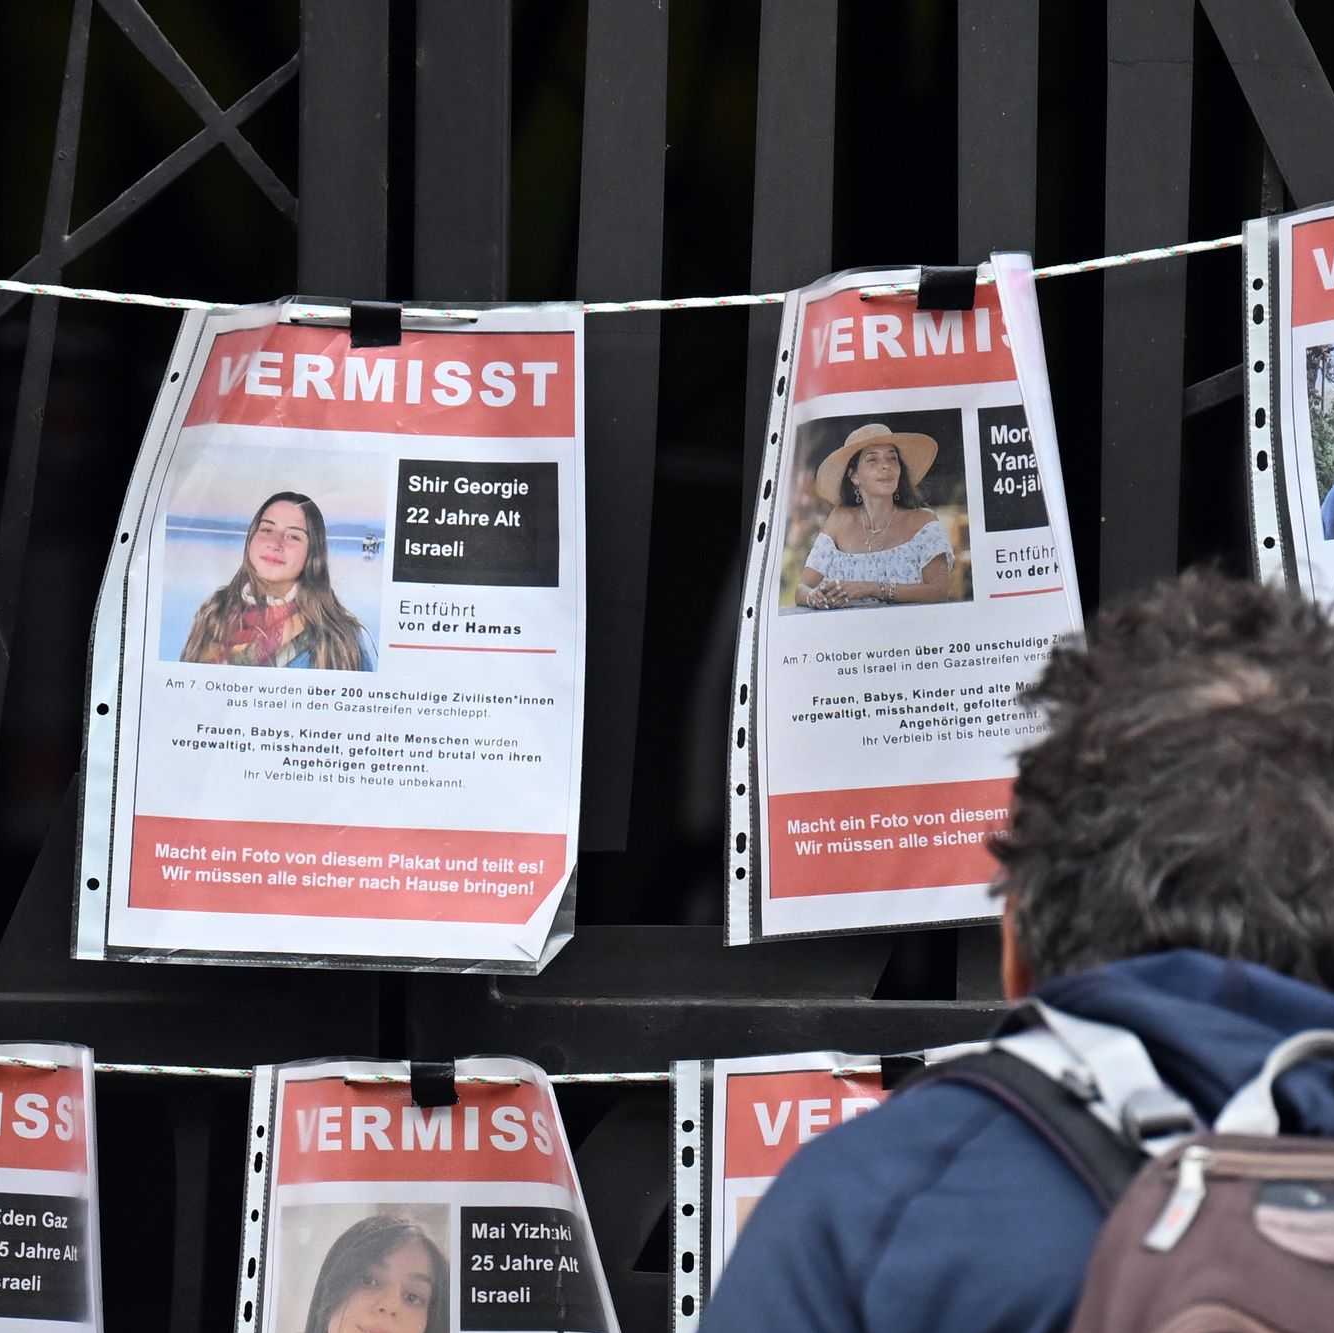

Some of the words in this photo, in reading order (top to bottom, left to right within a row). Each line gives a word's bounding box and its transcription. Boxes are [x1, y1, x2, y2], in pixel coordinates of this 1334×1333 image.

[811, 307, 1012, 367] VERMI
[219, 351, 558, 407] VERMISST
[991, 421, 1034, 447] Mor
[991, 445, 1037, 471] Yana
[408, 475, 449, 493] Shir
[454, 477, 529, 499] Georgie
[993, 470, 1042, 497] 40-jä
[406, 507, 429, 523] 22
[435, 508, 489, 526] Jahre
[494, 510, 520, 527] Alt
[405, 539, 464, 557] Israeli
[155, 843, 207, 860] Macht
[211, 847, 237, 861] ein
[242, 847, 280, 863] Foto
[285, 853, 317, 864] von
[321, 851, 383, 868] diesem
[388, 853, 441, 870] Plakat
[445, 857, 478, 871] und
[482, 858, 514, 873] teilt
[518, 859, 544, 874] es!
[296, 1105, 554, 1155] VERMISS
[42, 1211, 68, 1229] Gaz
[472, 1223, 505, 1239] Mai
[14, 1242, 61, 1260] Jahre
[63, 1245, 78, 1261] Alt
[471, 1255, 494, 1271] 25
[500, 1255, 554, 1271] Jahre
[558, 1256, 579, 1273] Alt
[472, 1287, 530, 1303] Israeli
